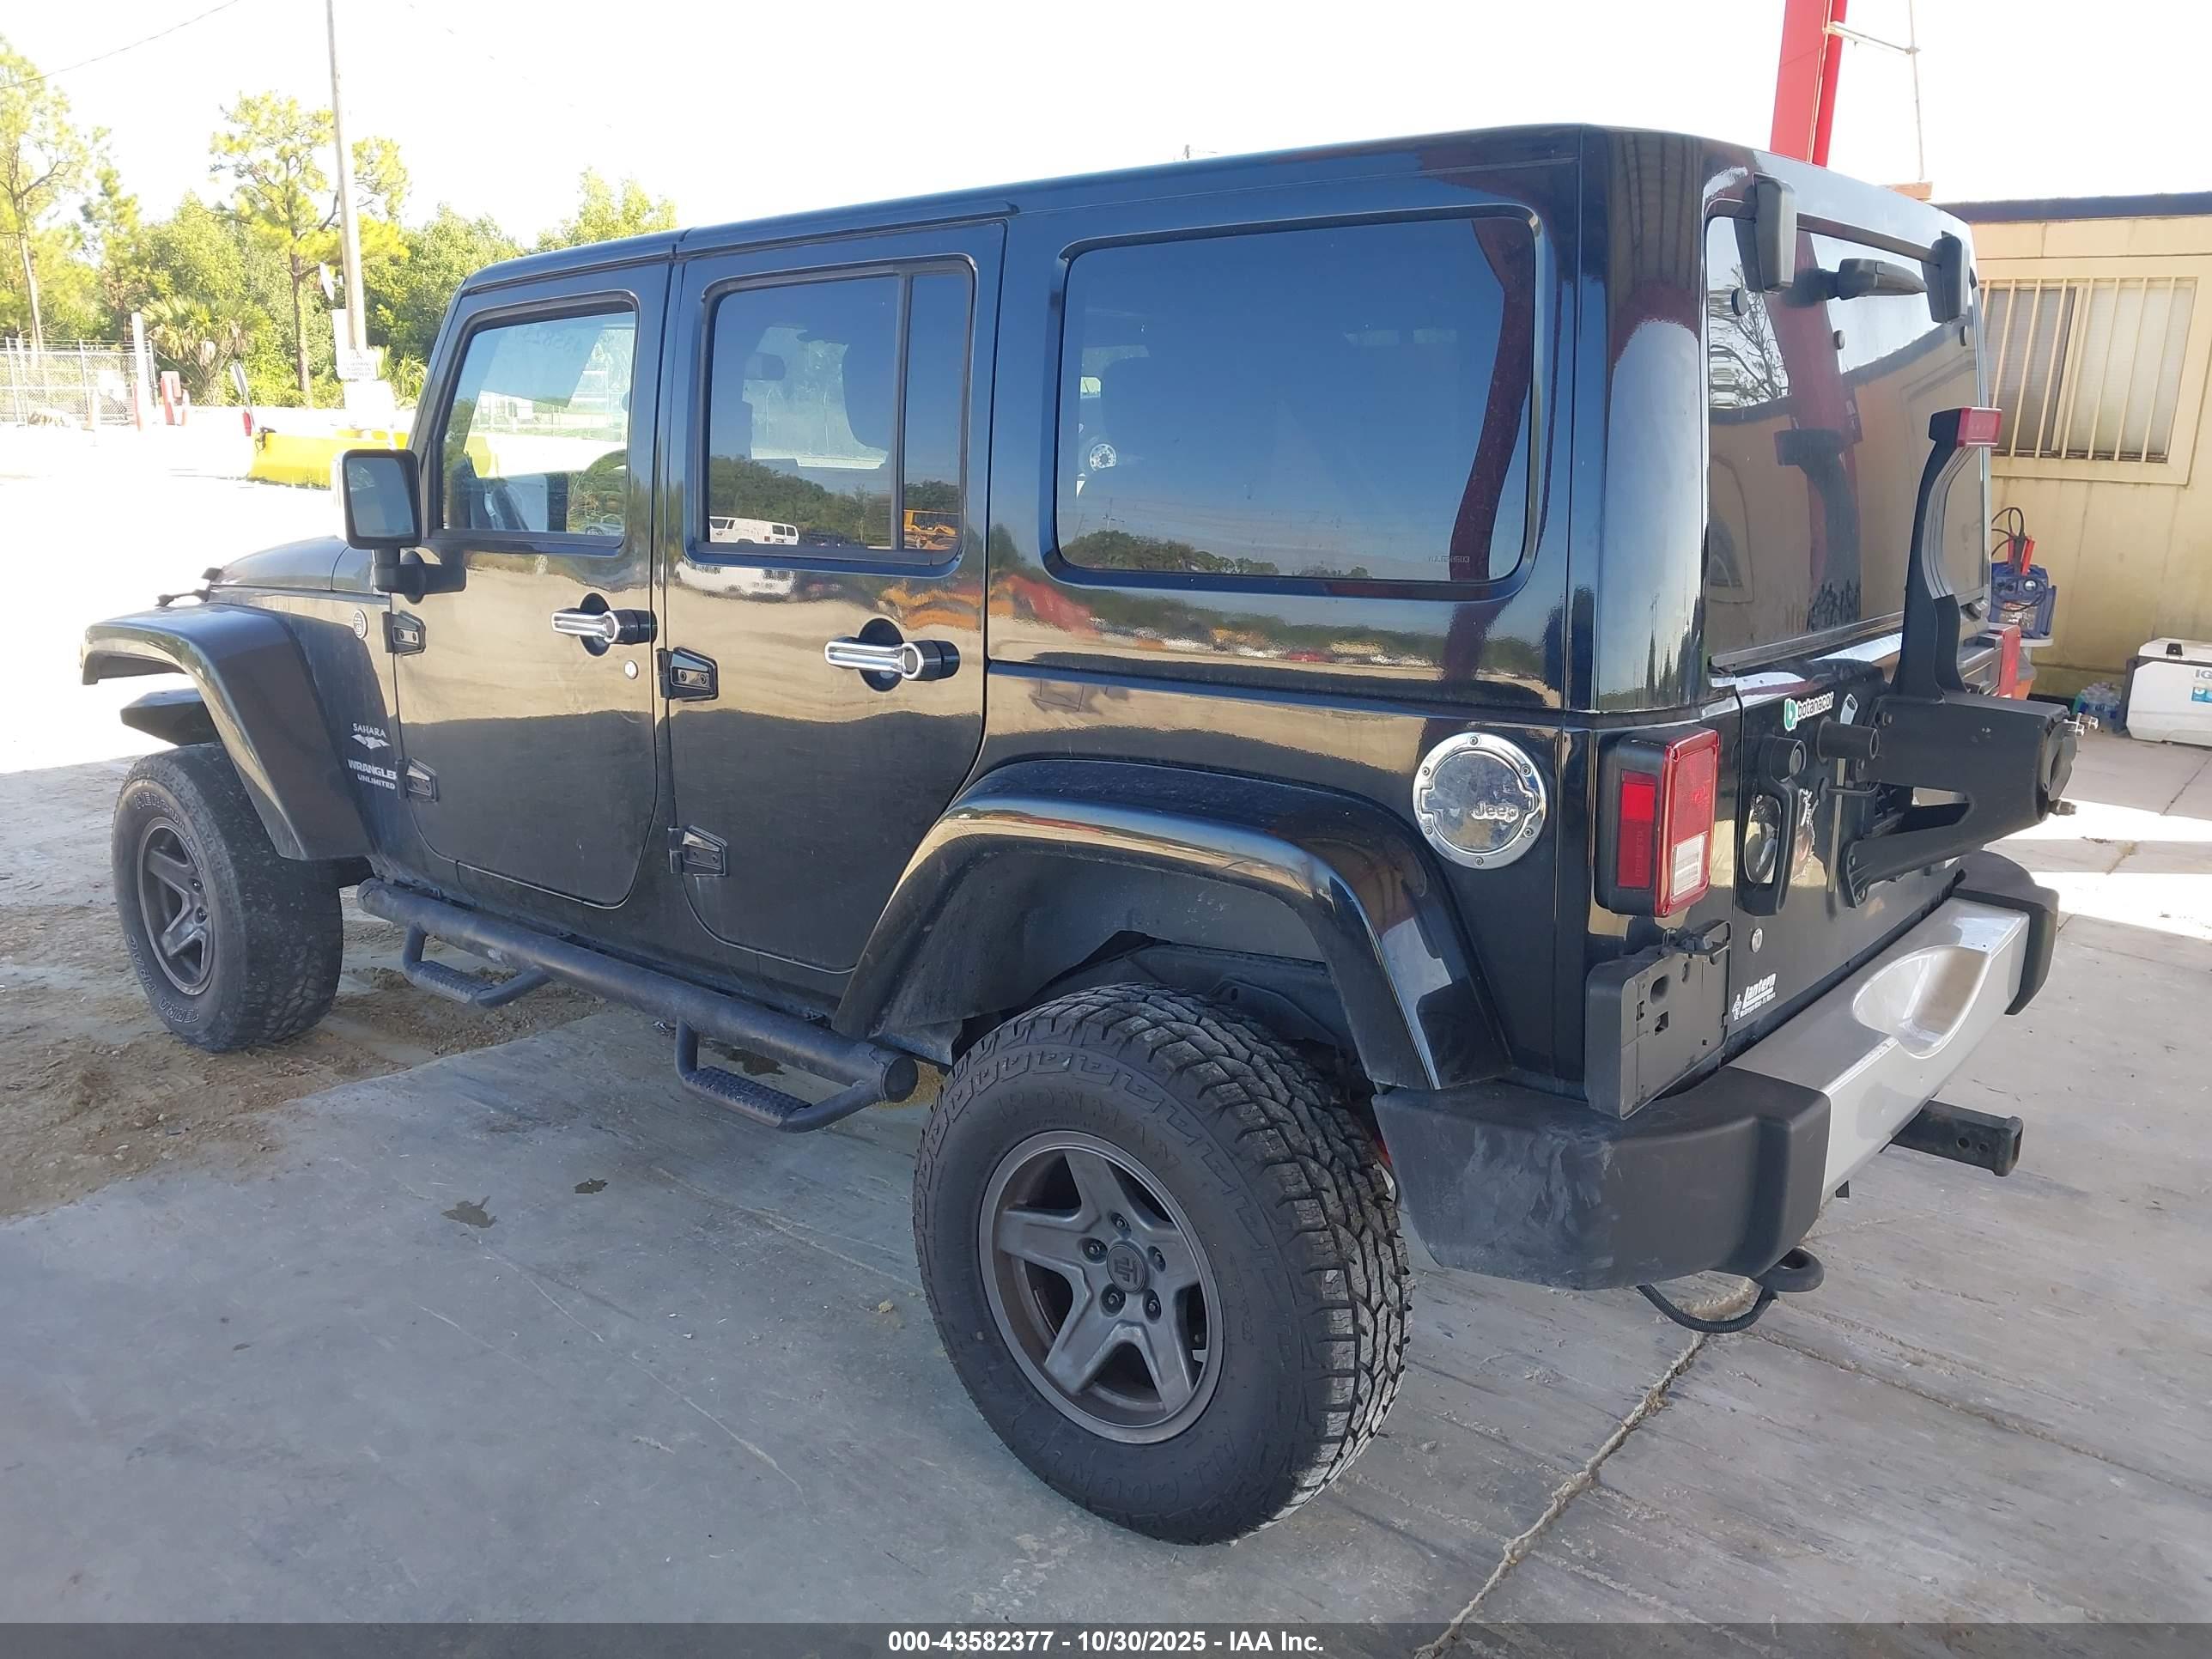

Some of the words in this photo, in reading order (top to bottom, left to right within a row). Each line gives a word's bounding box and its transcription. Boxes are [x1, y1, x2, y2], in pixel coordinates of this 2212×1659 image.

[1797, 691, 1834, 720] botanacor
[352, 722, 386, 738] SAHARA
[356, 773, 396, 790] UNLIMITED
[1471, 801, 1519, 823] Jeep
[1742, 972, 1777, 1010] Lantern
